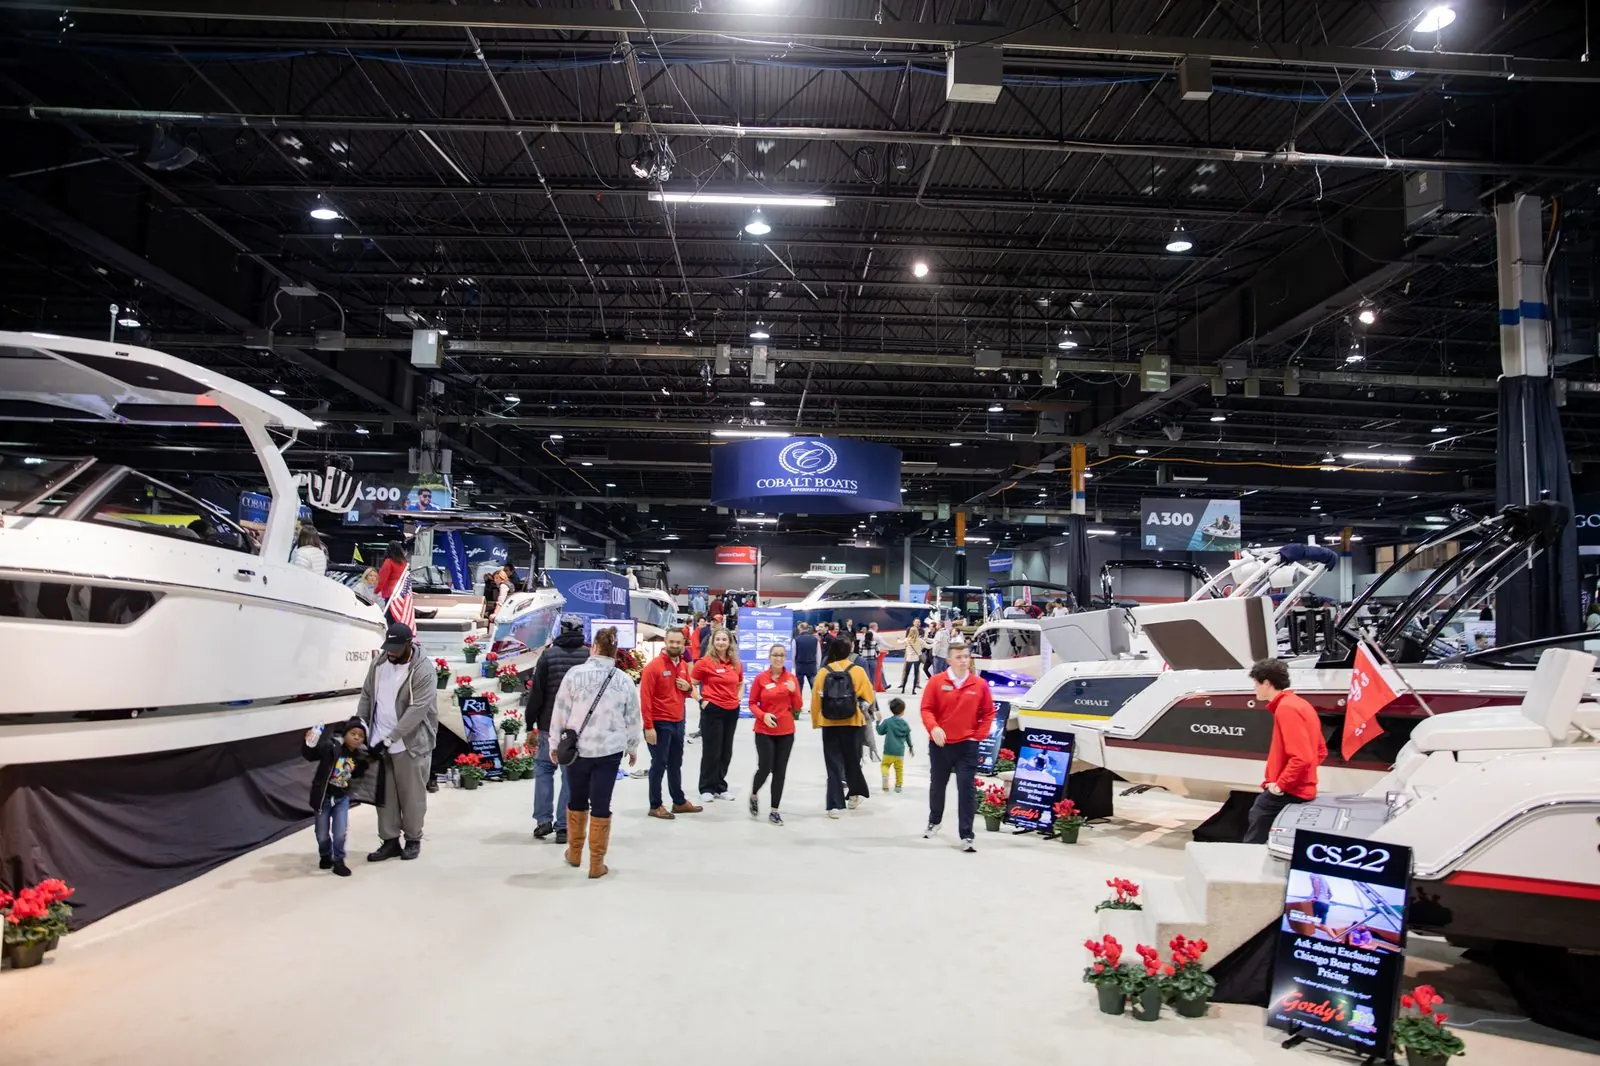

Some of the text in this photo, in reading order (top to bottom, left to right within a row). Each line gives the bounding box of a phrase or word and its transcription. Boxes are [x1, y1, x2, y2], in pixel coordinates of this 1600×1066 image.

[756, 477, 858, 490] COBALT BOATS
[1146, 512, 1194, 527] A300
[345, 651, 370, 662] COBALT
[462, 699, 487, 712] R31
[1074, 698, 1110, 707] COBALT
[1190, 723, 1246, 737] COBALT
[1306, 843, 1391, 873] CS22
[1294, 937, 1381, 964] Ask about Exclusive
[1294, 949, 1378, 976] Chicago Boat Show
[1317, 967, 1350, 984] Pricing
[1281, 991, 1346, 1022] Gordy's
